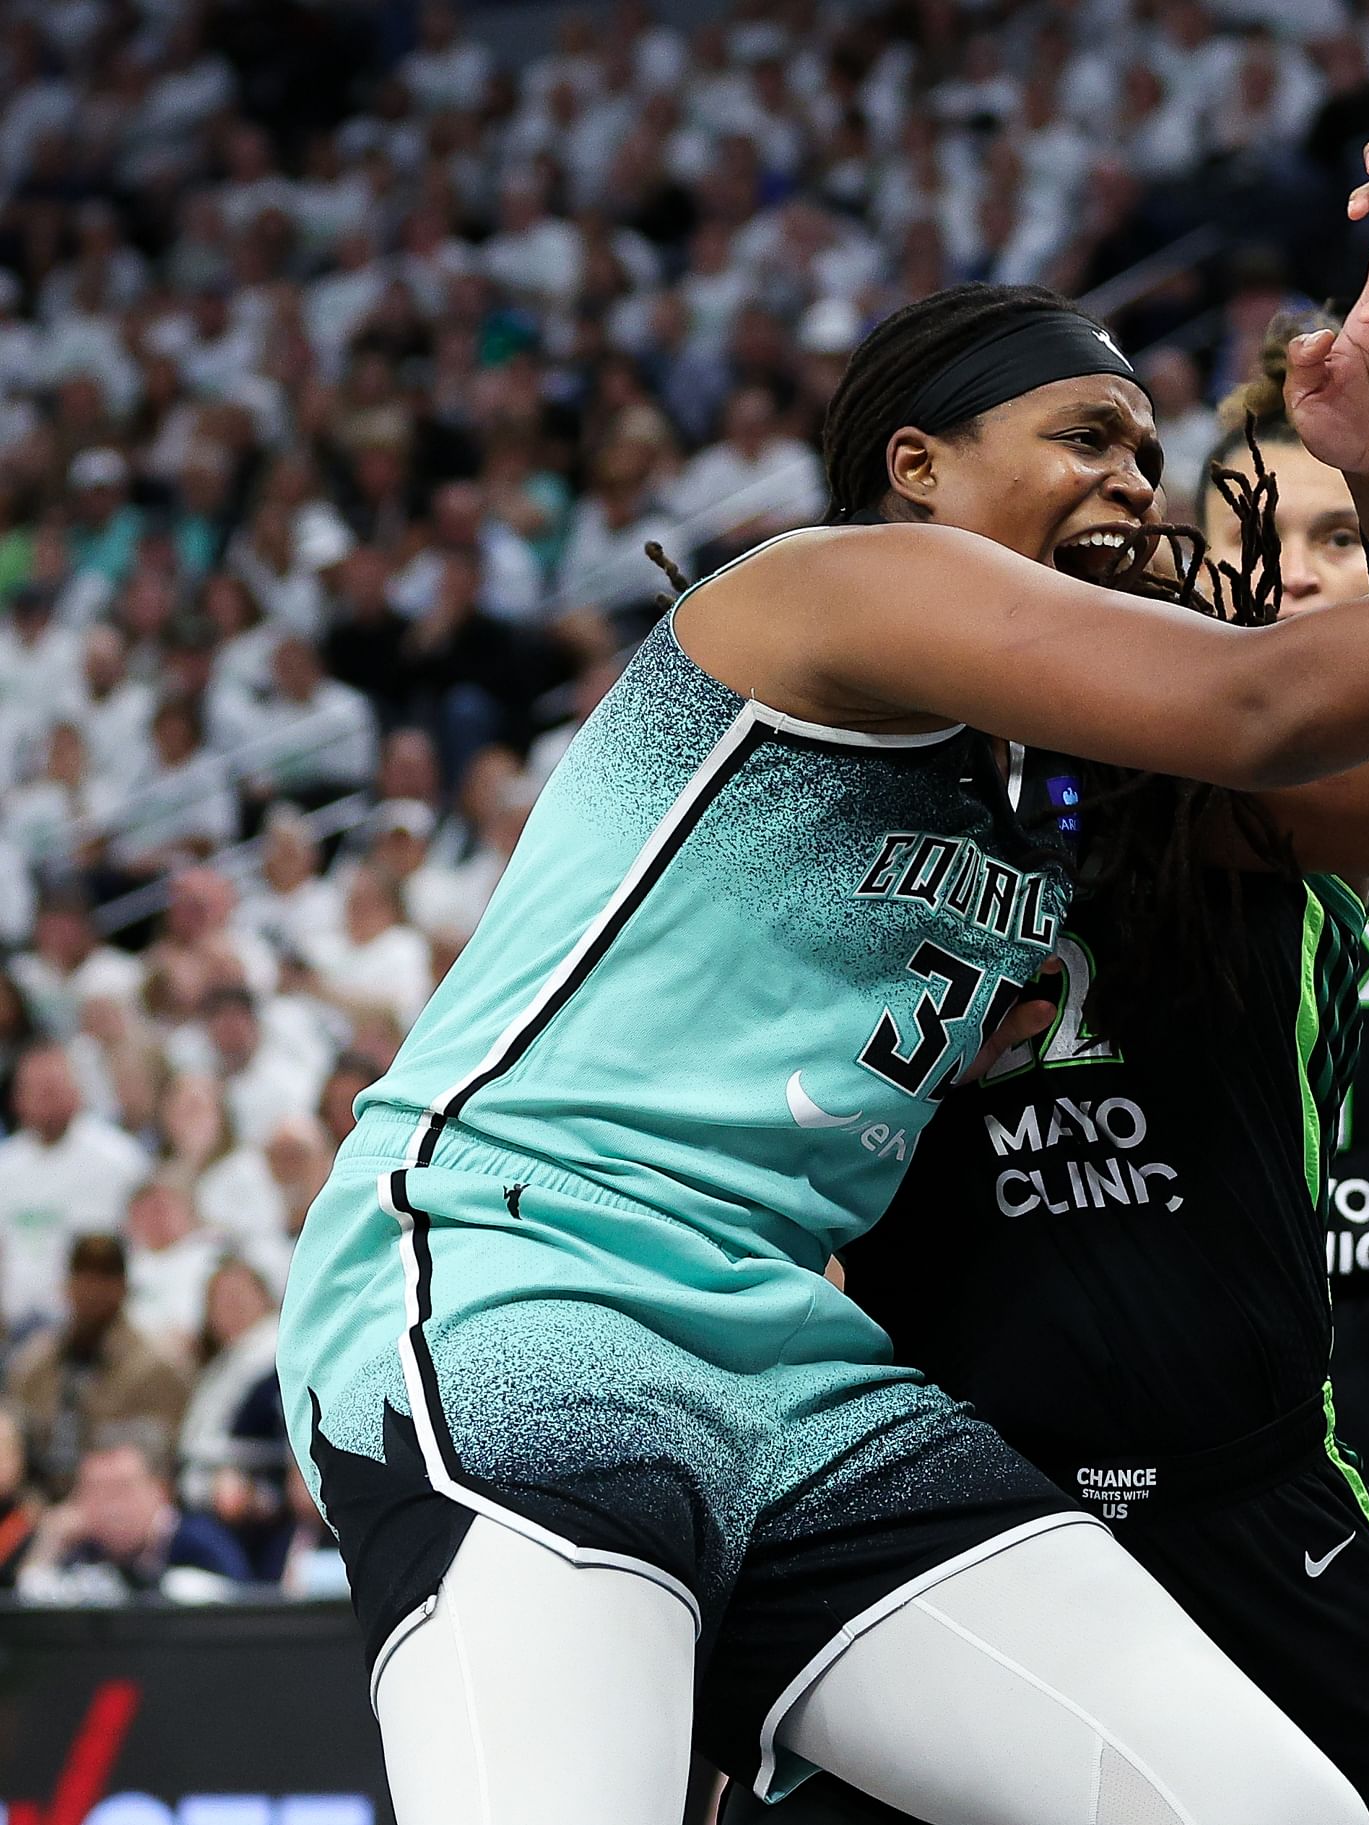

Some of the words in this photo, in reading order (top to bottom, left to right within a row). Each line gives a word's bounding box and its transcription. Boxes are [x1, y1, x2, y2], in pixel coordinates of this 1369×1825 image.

[852, 831, 1057, 948] EQUAL
[983, 1096, 1147, 1157] MAYO
[995, 1157, 1185, 1218] CLINIC
[1077, 1467, 1157, 1488] CHANGE
[1082, 1488, 1121, 1501] STARTS
[1123, 1489, 1150, 1501] WITH
[1102, 1503, 1128, 1519] US
